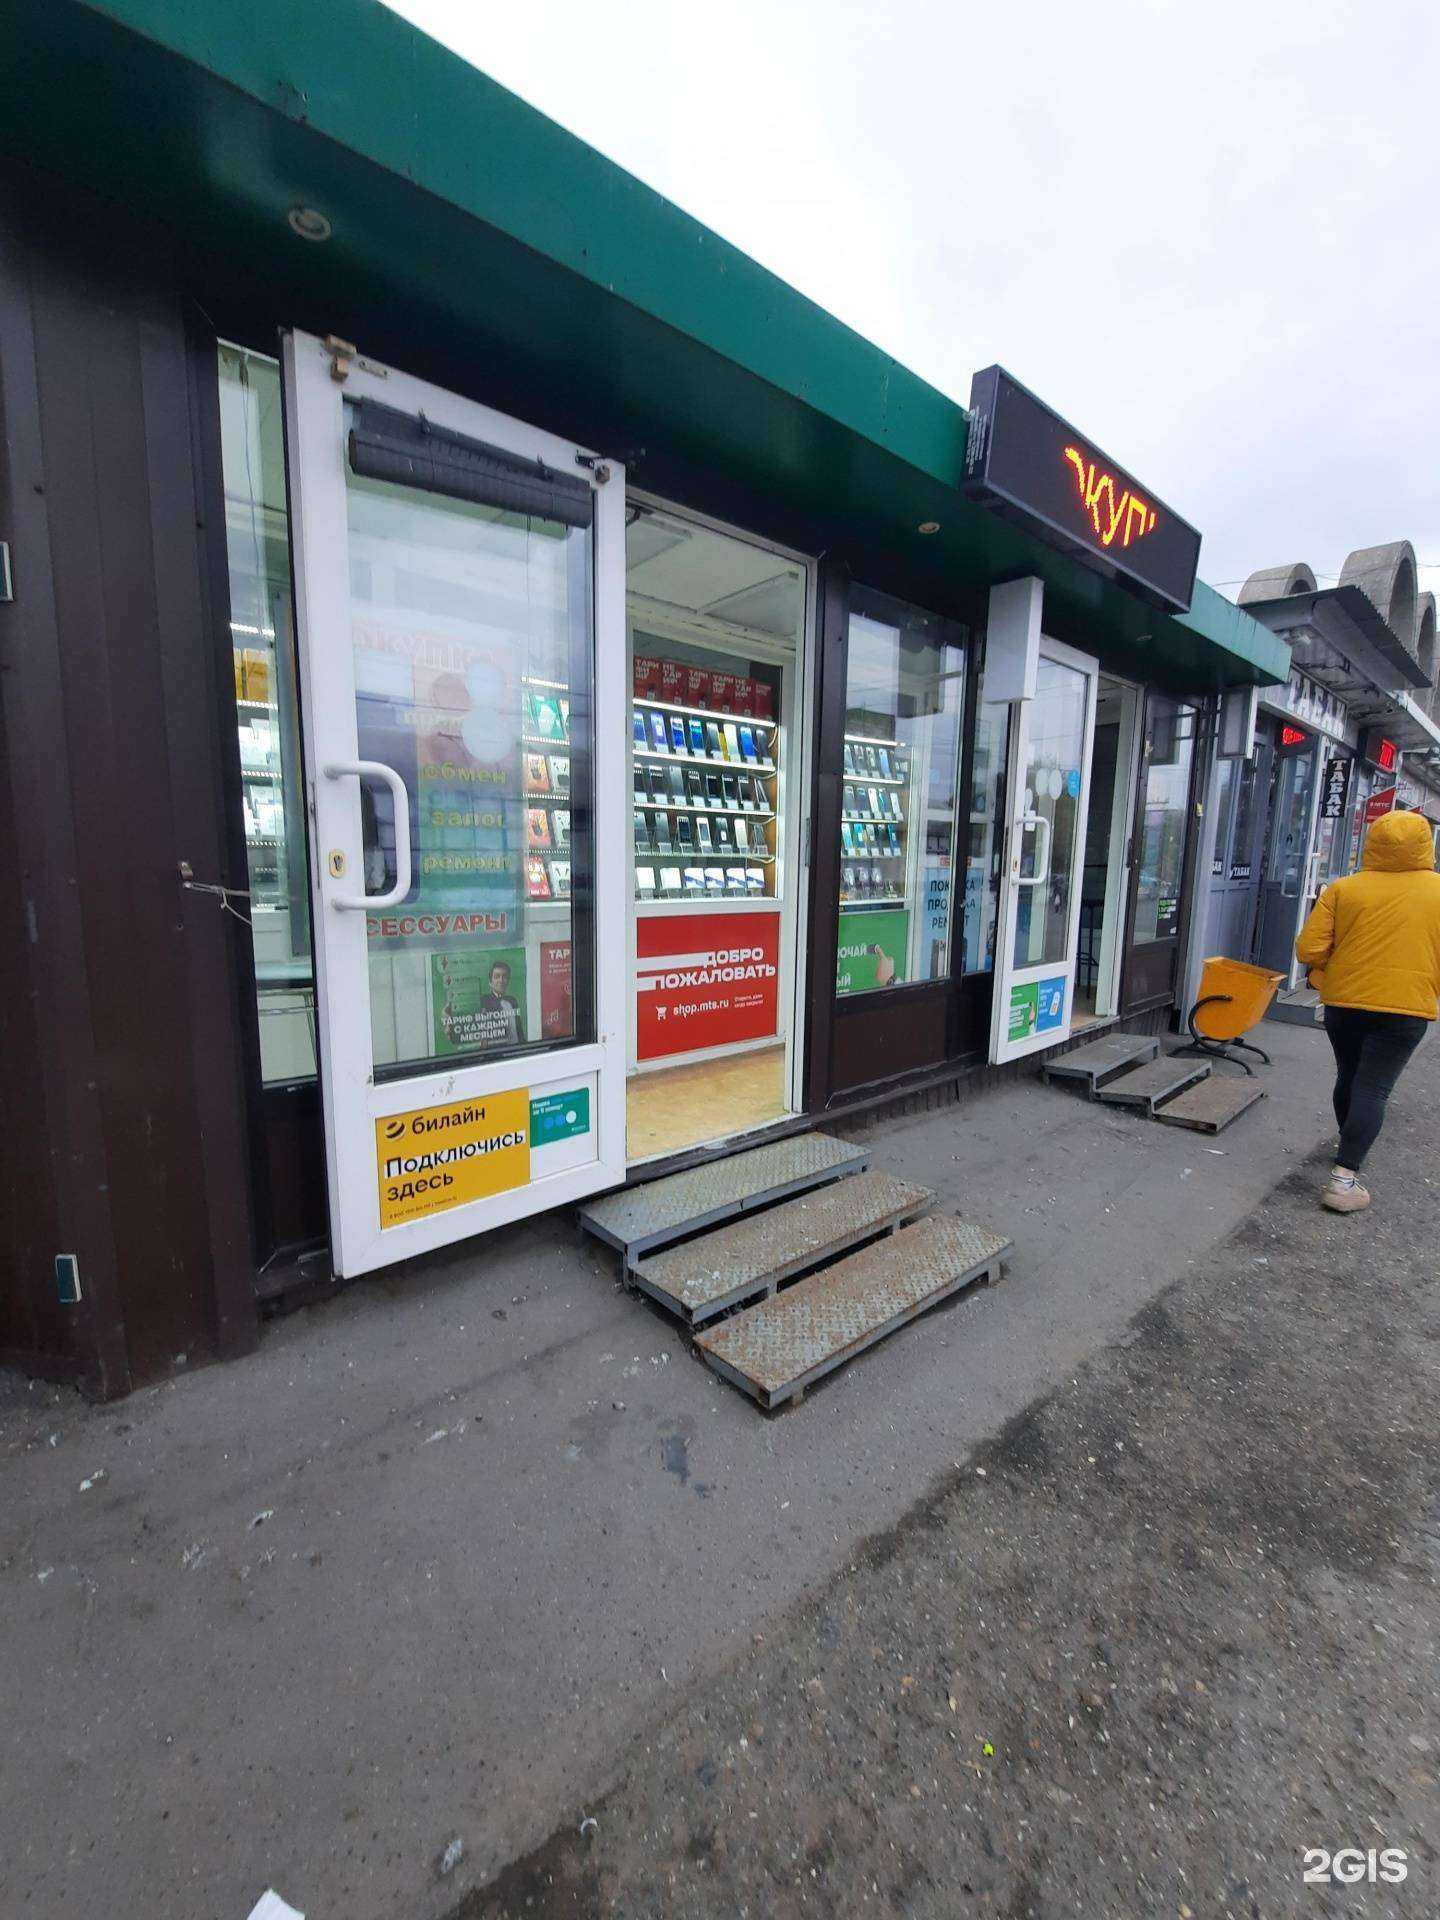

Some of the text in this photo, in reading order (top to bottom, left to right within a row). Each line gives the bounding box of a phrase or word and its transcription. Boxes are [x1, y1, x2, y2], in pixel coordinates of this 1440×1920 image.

[423, 763, 506, 784] обмен
[1325, 760, 1347, 817] ТАБАК
[703, 947, 765, 968] ДОБРО
[655, 964, 776, 990] ПОЖАЛОВАТЬ
[673, 999, 730, 1018] shop.mts.ru
[460, 1028, 507, 1042] МЕСЯЦЕМ
[463, 1019, 510, 1032] КАЖДЫМ
[411, 1106, 486, 1134] билайн
[386, 1131, 525, 1178] Подключись
[387, 1171, 454, 1203] здесь
